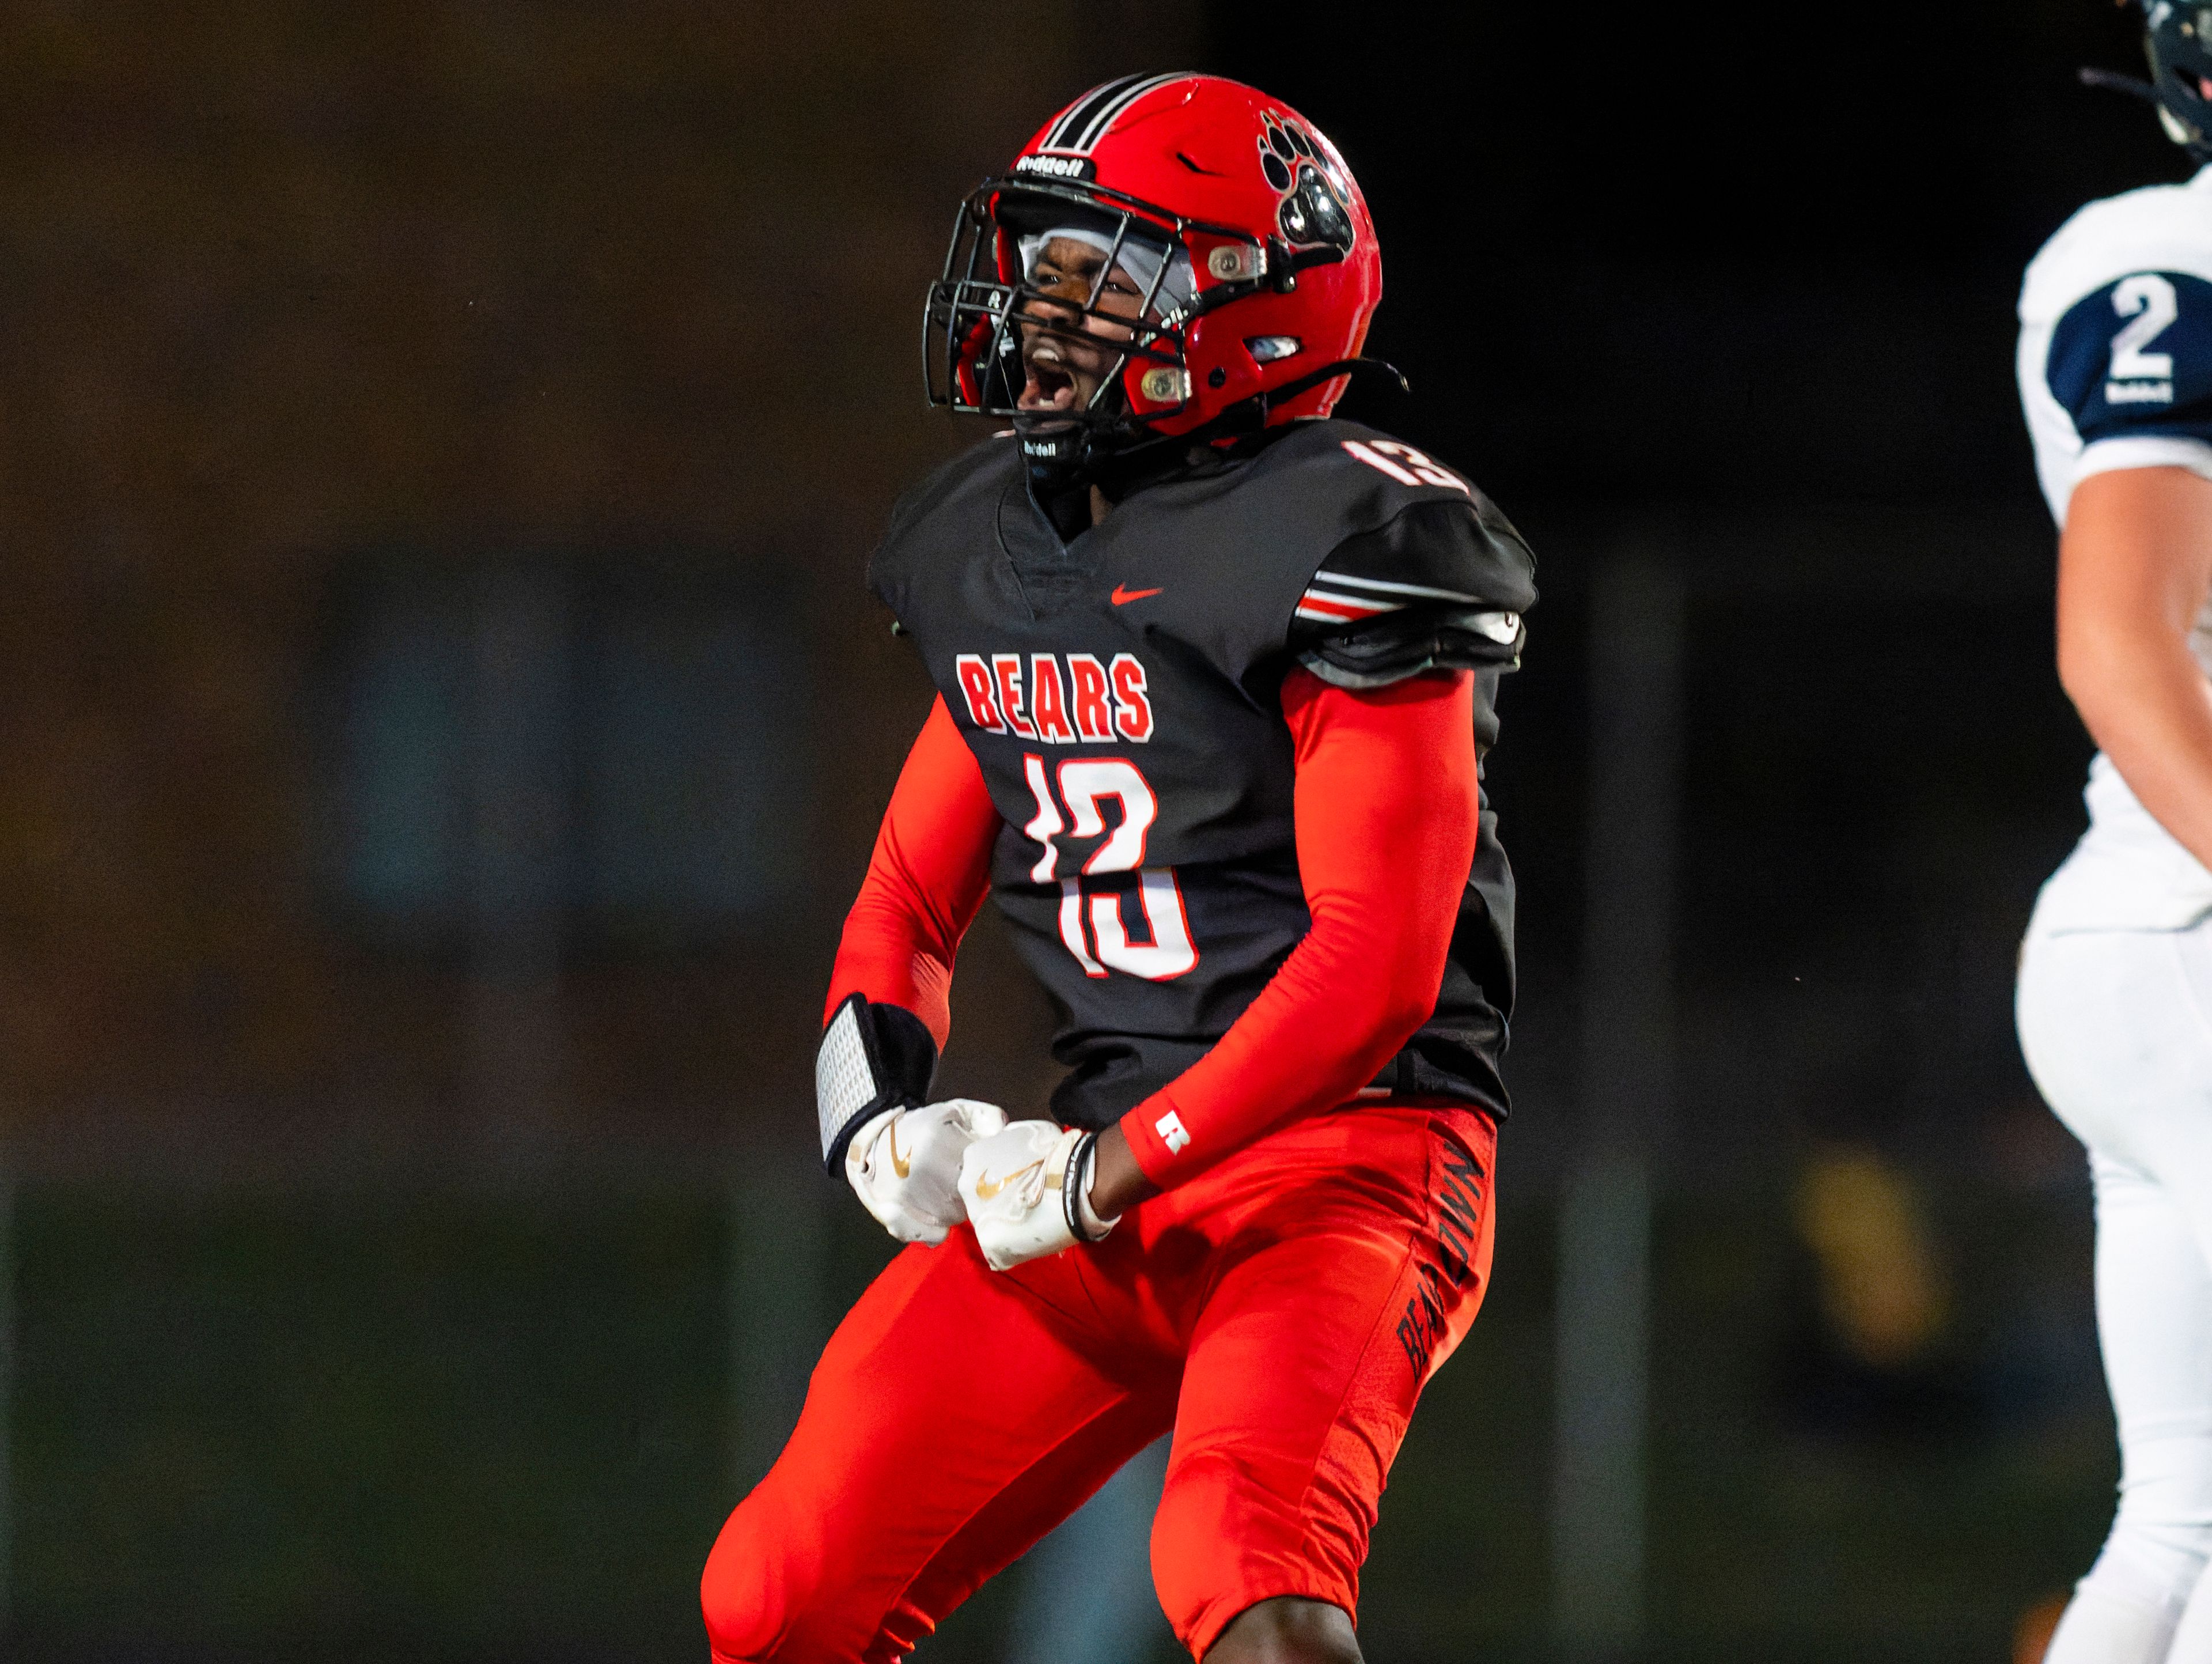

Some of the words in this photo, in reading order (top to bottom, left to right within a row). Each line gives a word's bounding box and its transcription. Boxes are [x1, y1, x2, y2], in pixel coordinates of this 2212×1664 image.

[2111, 274, 2179, 379] 2
[1340, 440, 1470, 497] 13
[956, 653, 1153, 744] BEARS
[1024, 752, 1199, 982] 13
